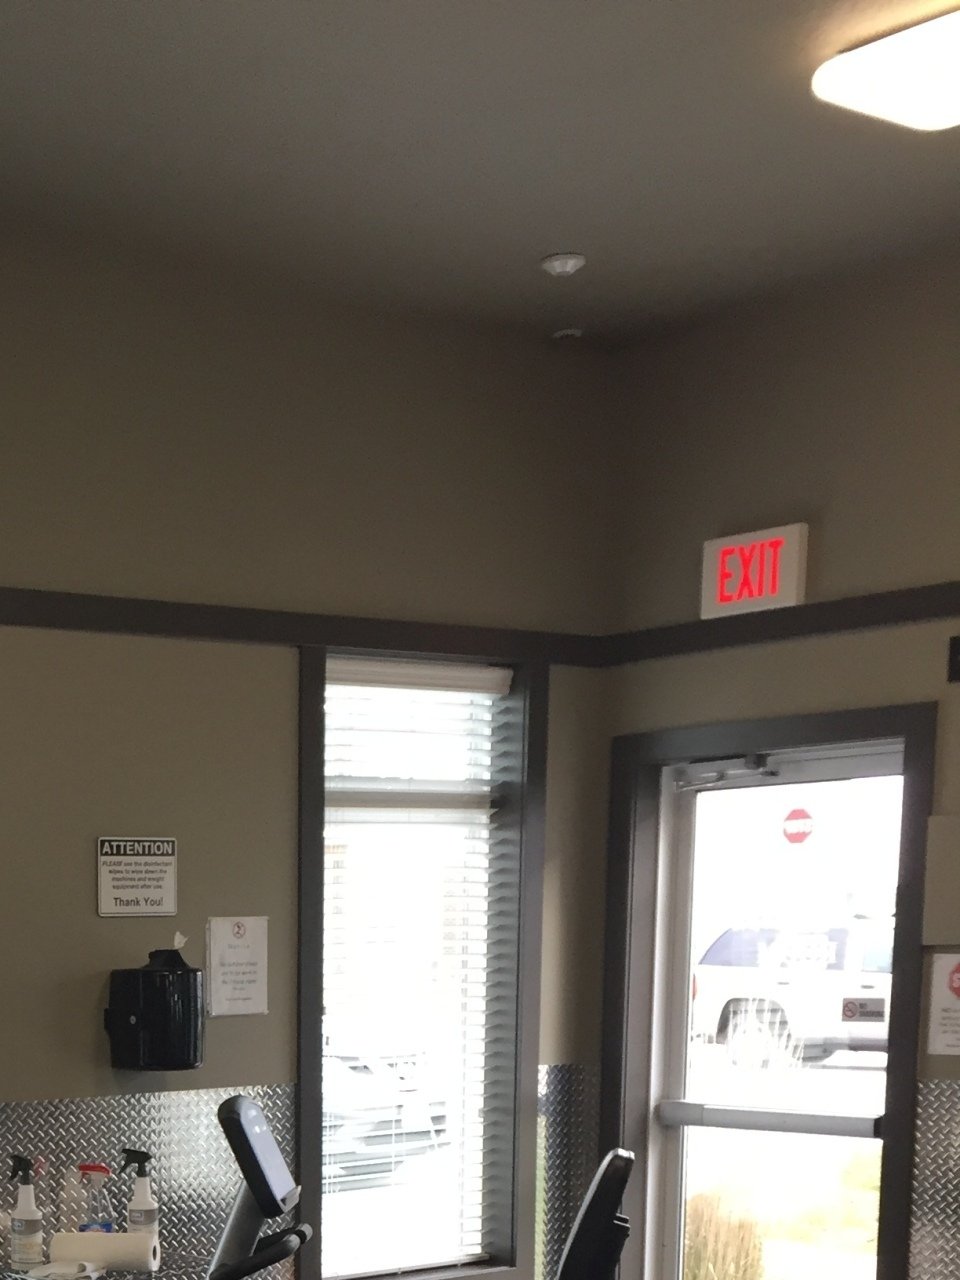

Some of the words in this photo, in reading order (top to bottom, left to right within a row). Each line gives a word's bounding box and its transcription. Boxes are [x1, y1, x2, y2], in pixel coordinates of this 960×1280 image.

[717, 537, 784, 602] EXIT
[102, 841, 173, 855] ATTENTION
[113, 896, 141, 907] Thank
[143, 896, 164, 907] You!
